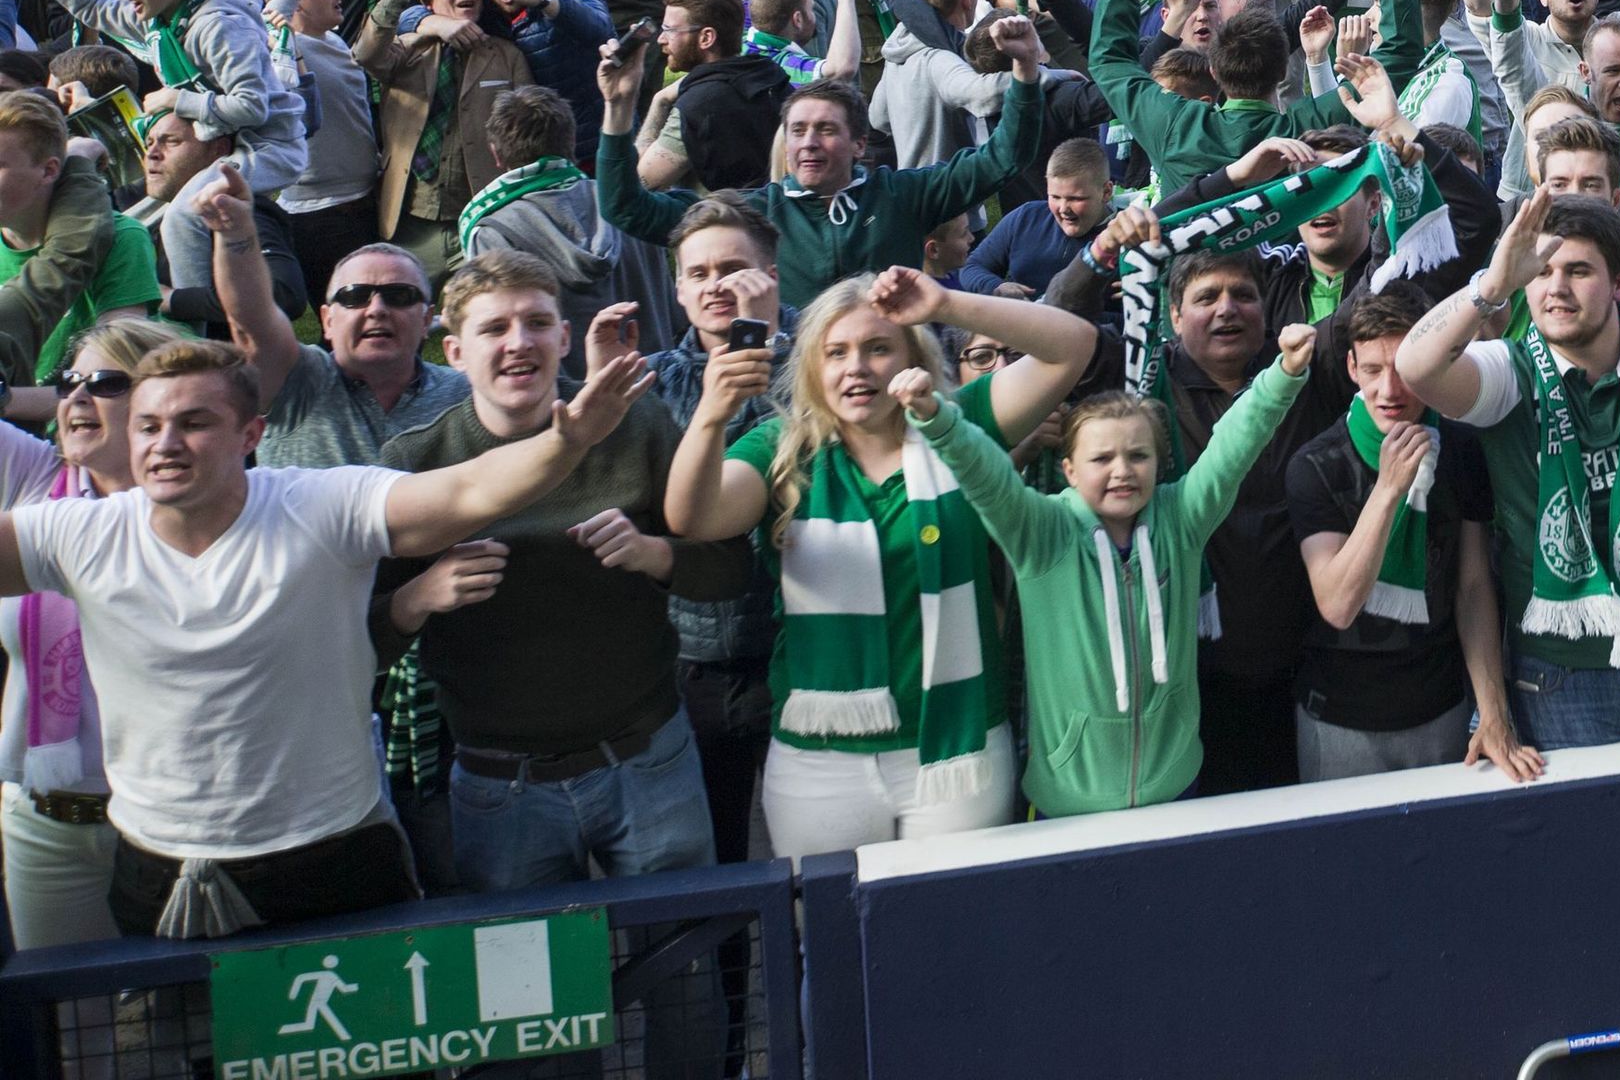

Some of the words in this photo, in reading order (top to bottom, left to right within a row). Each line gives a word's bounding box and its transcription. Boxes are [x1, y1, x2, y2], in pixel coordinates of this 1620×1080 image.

[1217, 211, 1282, 251] ROAD
[1527, 329, 1555, 384] TRUE
[1549, 385, 1564, 402] A
[1556, 407, 1576, 442] I'M
[222, 1026, 497, 1080] EMERGENCY
[516, 1012, 607, 1054] EXIT
